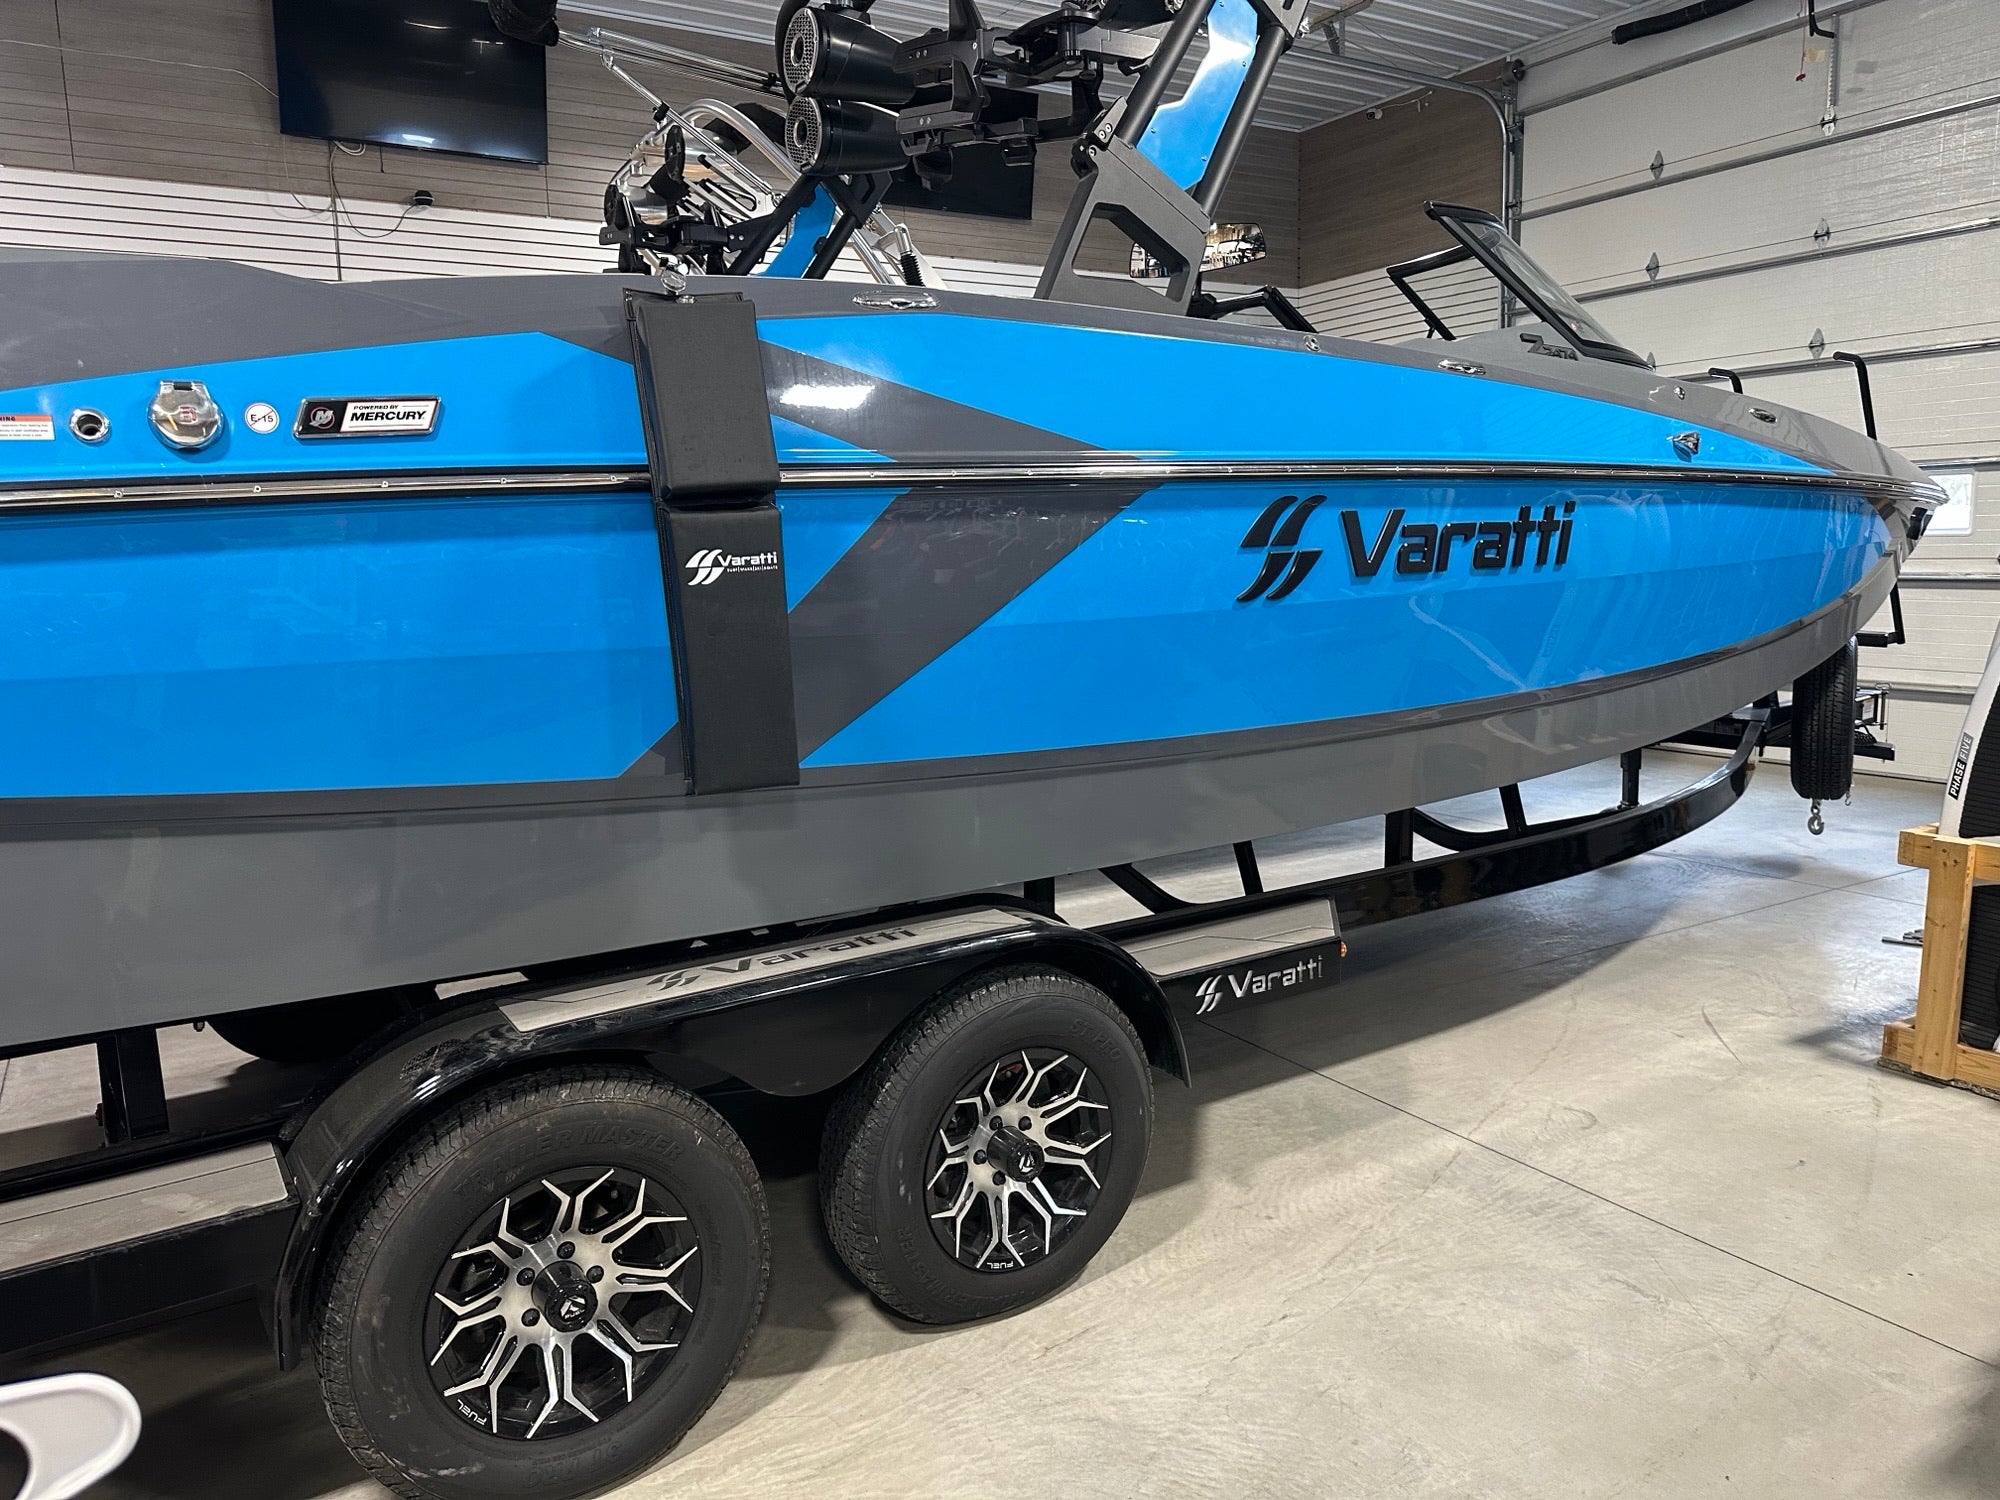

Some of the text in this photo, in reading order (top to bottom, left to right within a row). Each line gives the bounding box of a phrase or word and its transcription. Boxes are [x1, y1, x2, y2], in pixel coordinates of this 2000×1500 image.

[250, 414, 274, 423] E-15
[350, 411, 427, 421] MERCURY
[1341, 500, 1577, 577] Varatti
[717, 552, 778, 567] Varatti
[1950, 737, 1972, 797] PHASE FIVE
[702, 927, 919, 974] Varatti
[1227, 955, 1323, 999] Varatti
[986, 1261, 1014, 1269] FUEL
[457, 1399, 488, 1426] FUEL
